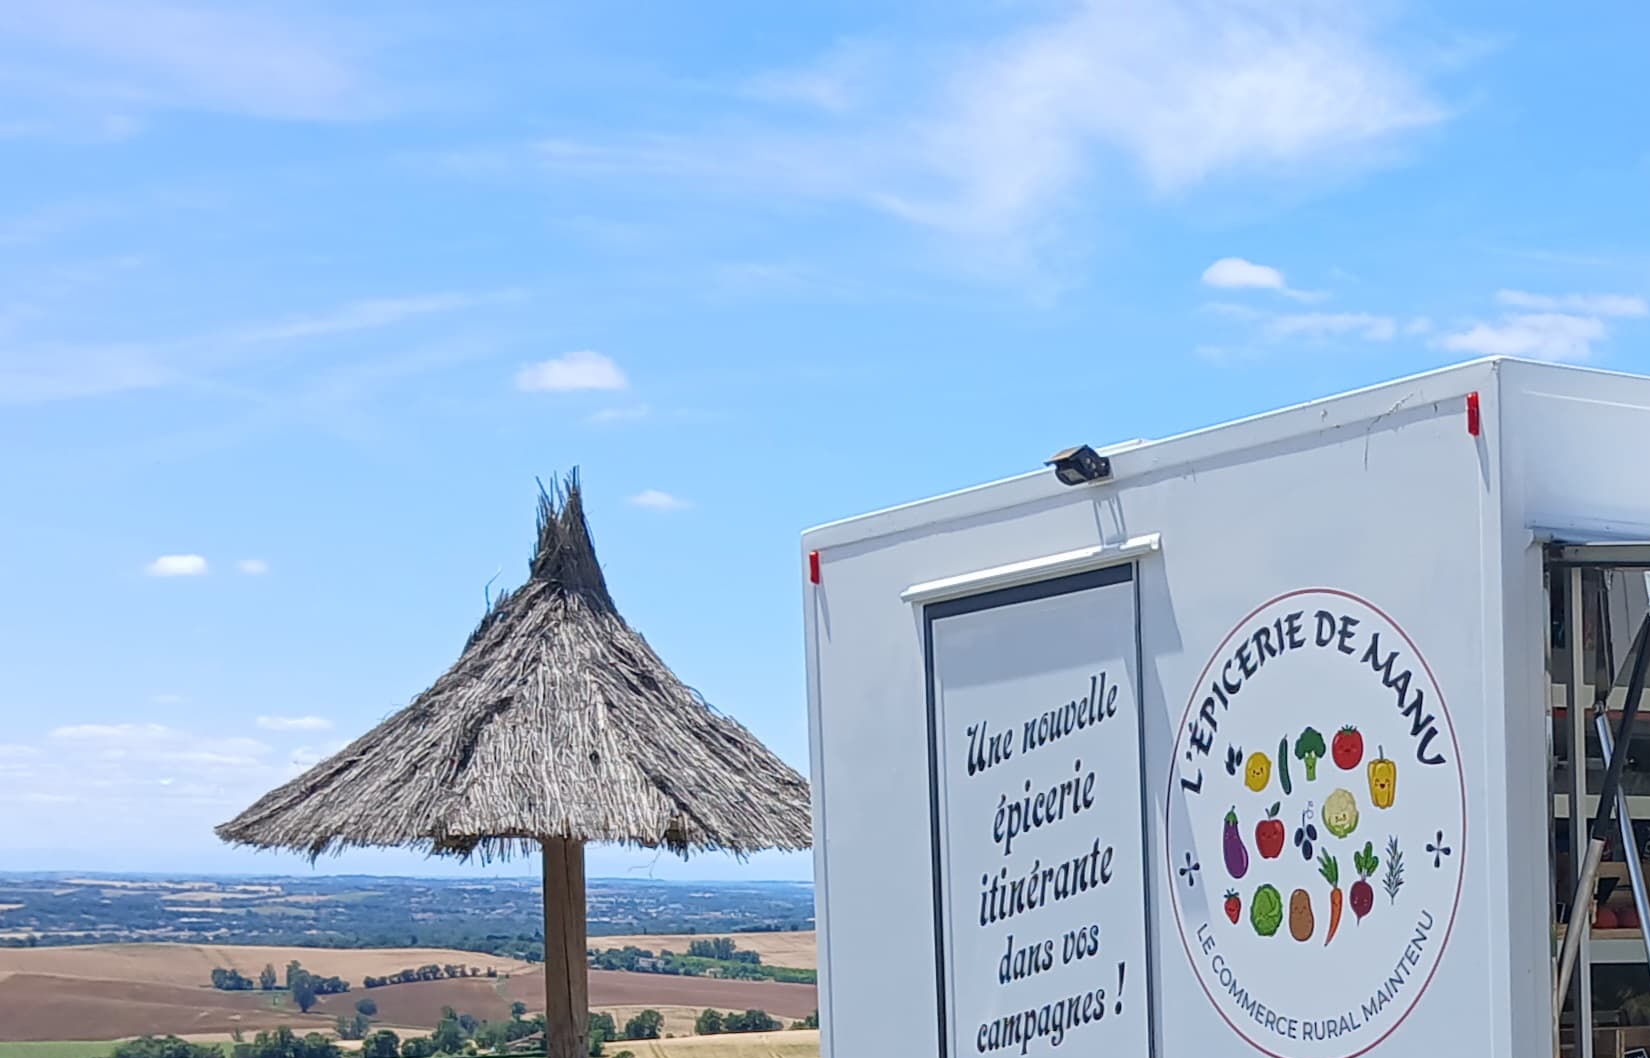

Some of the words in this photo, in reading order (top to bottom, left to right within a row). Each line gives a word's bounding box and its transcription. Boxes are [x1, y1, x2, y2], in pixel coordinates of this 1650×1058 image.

[967, 721, 1012, 776] Une
[1023, 672, 1117, 749] nouvelle
[1315, 609, 1361, 655] DE
[1361, 632, 1446, 766] MANU
[993, 758, 1096, 846] épicerie
[980, 842, 1113, 926] itinérante
[999, 935, 1053, 984] dans
[1063, 925, 1099, 964] vos
[1196, 922, 1214, 951] LE
[1211, 953, 1298, 1040] COMMERCE
[1302, 1011, 1361, 1041] RURAL
[1360, 909, 1434, 1022] MAINTENU
[976, 989, 1106, 1056] campagnes
[1115, 962, 1125, 1015] !
